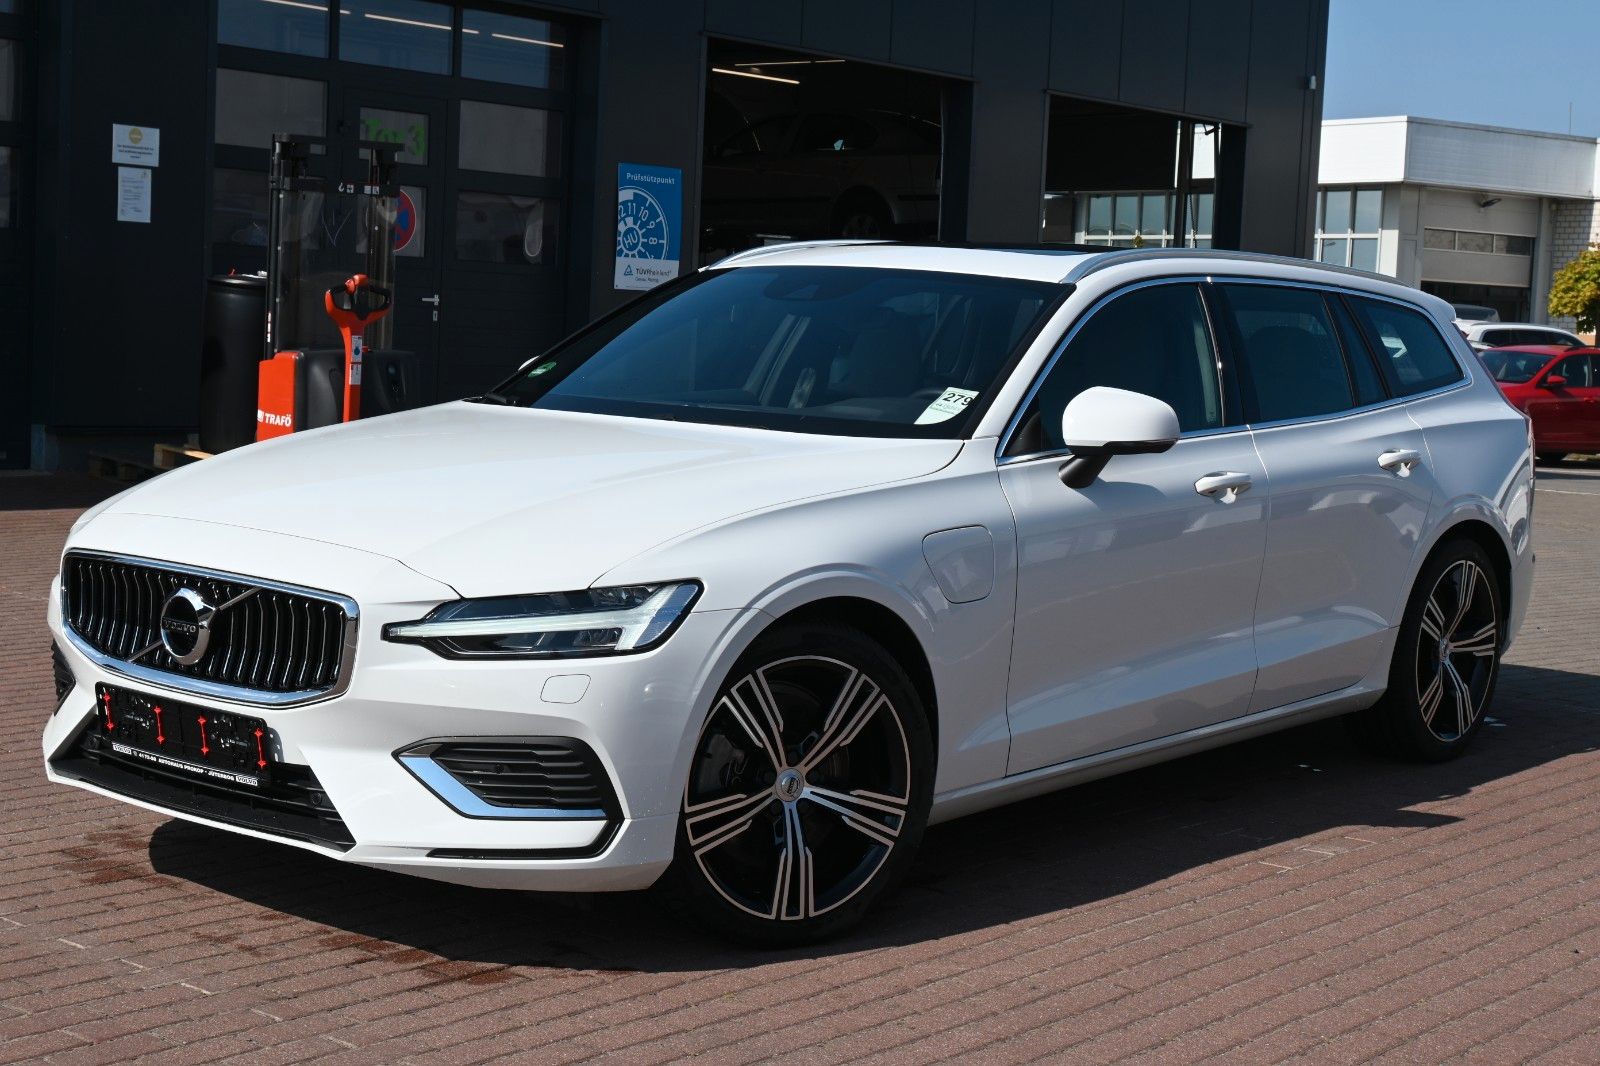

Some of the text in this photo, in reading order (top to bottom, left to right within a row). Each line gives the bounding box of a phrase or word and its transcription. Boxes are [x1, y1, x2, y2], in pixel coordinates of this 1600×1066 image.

[626, 173, 675, 185] Prüfstützpunkt
[623, 229, 638, 249] HU
[648, 237, 658, 245] 8
[942, 392, 974, 406] 279
[265, 413, 292, 427] TRAFÖ
